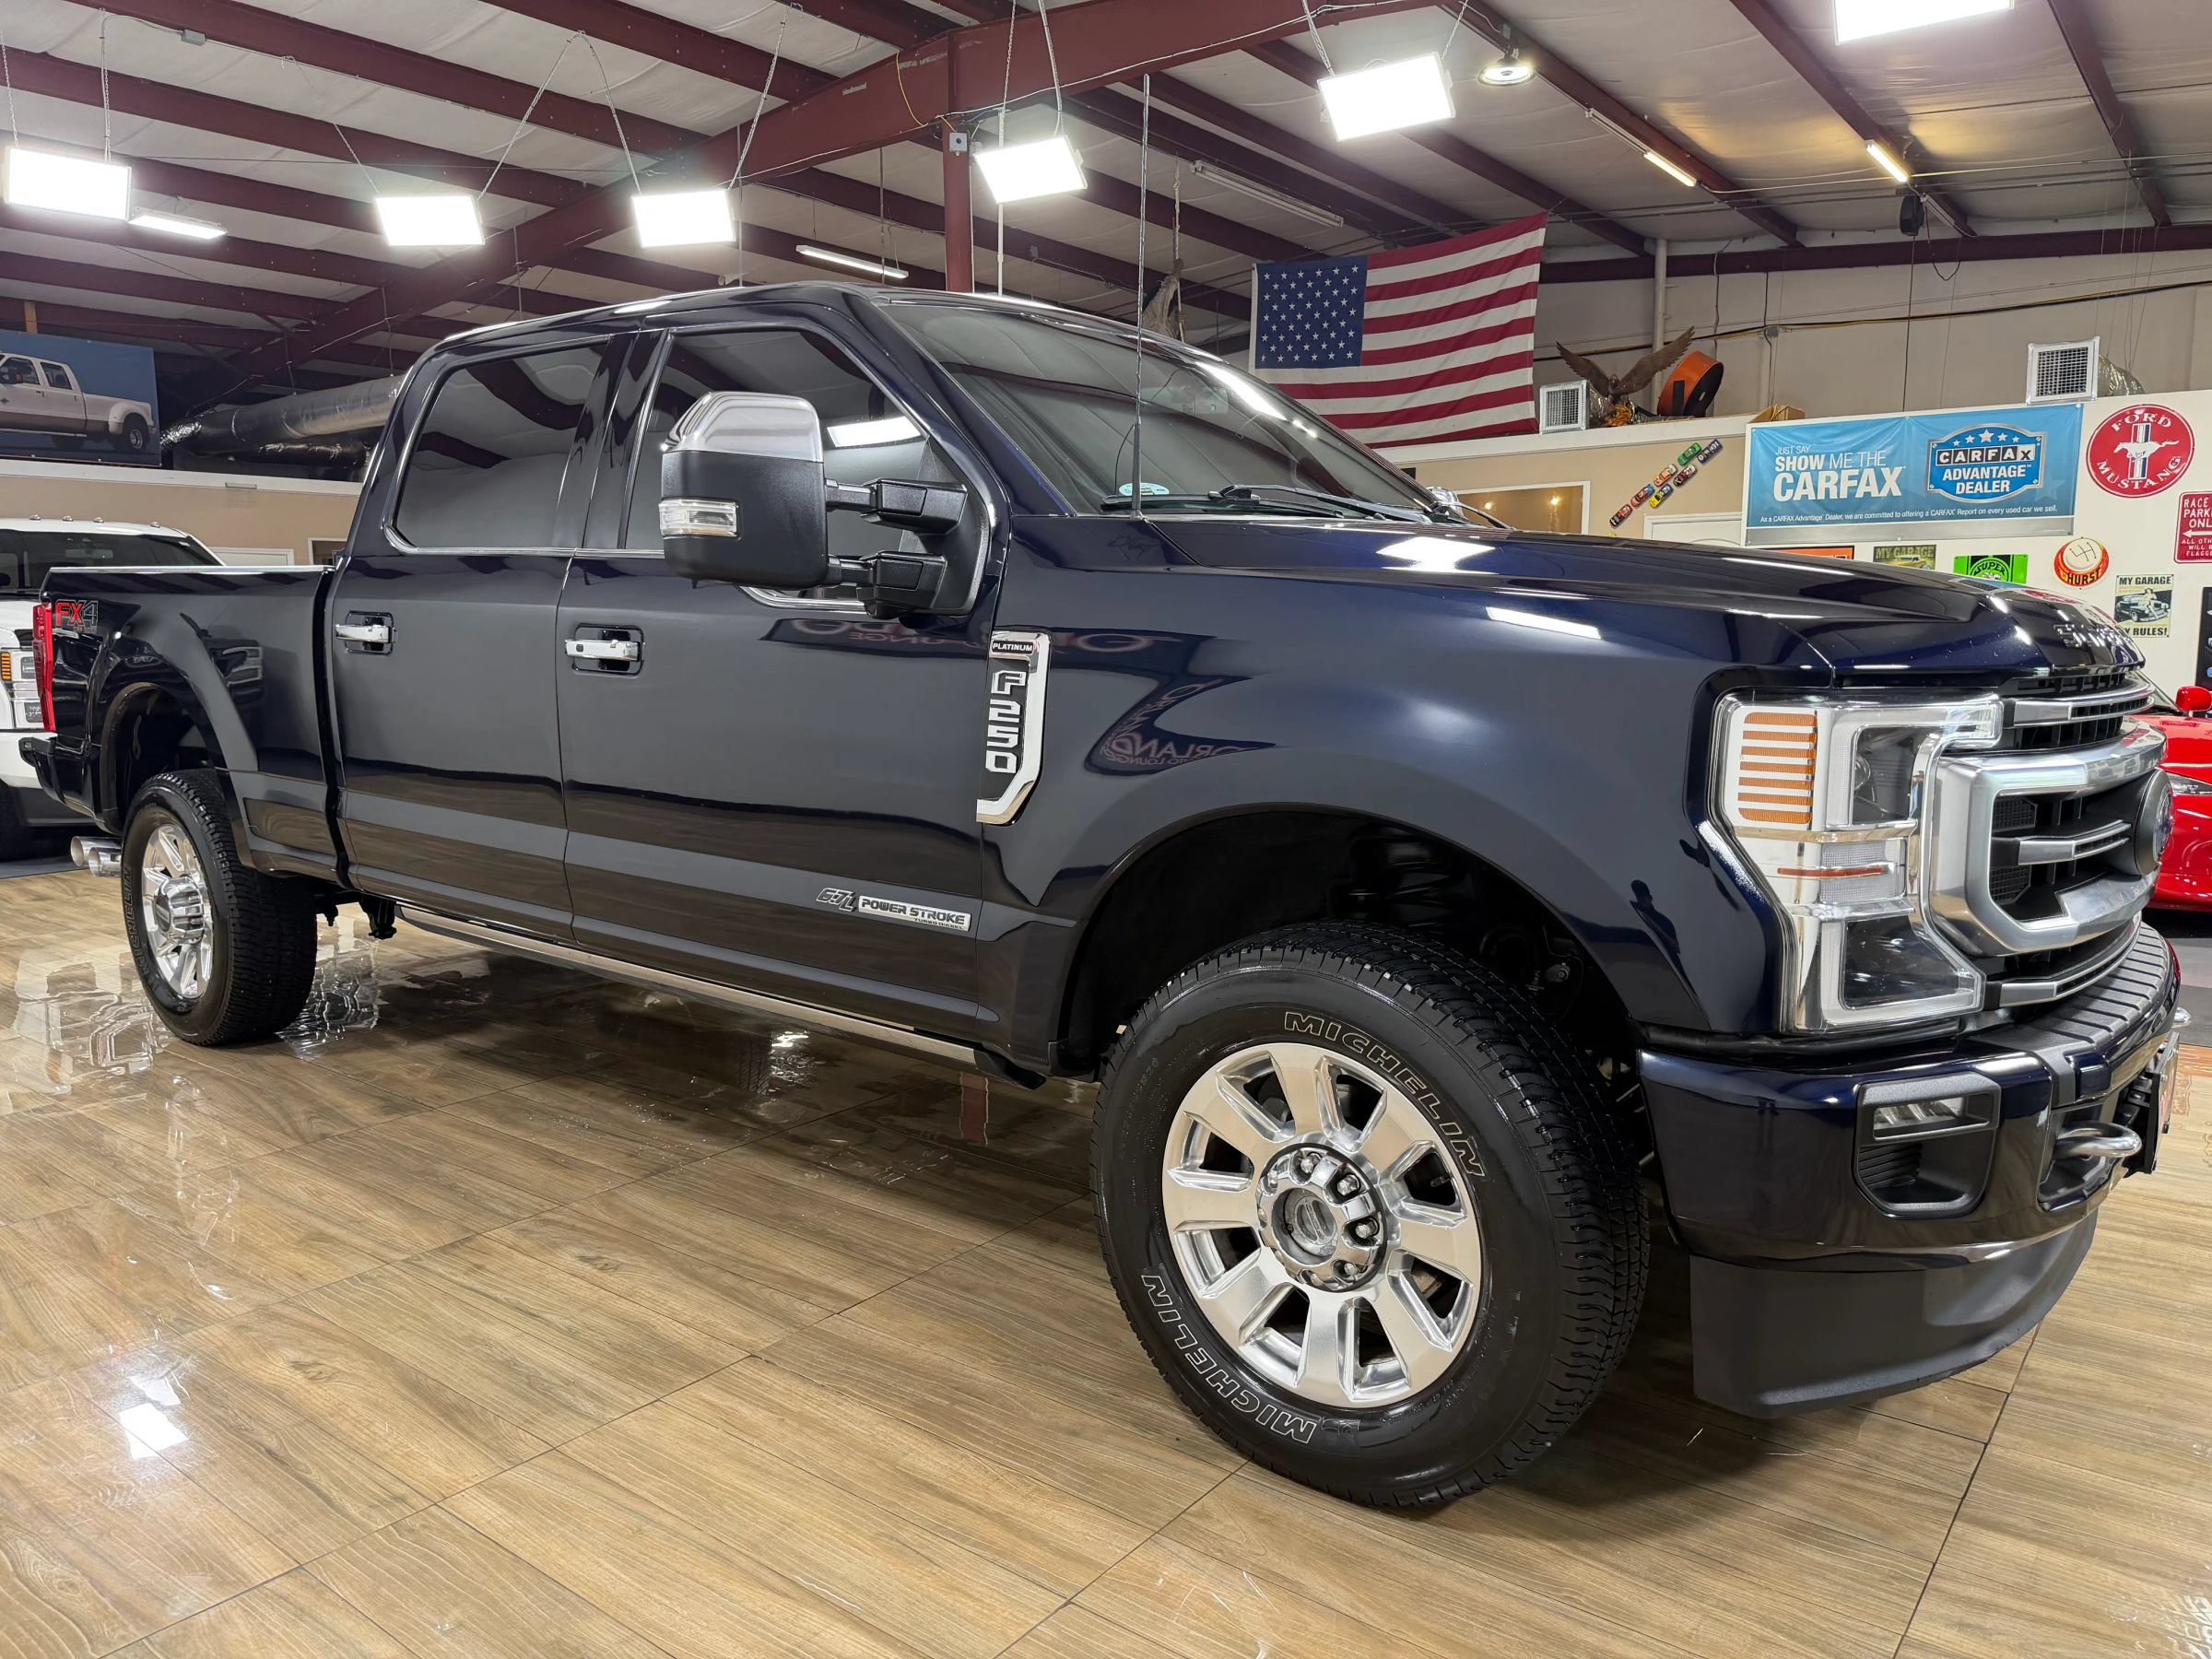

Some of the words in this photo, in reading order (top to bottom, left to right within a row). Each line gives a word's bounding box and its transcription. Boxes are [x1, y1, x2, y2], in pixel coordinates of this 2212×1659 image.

[2111, 412, 2171, 432] FORD
[1775, 446, 1793, 456] JUST
[1795, 444, 1811, 454] SAY
[1938, 447, 2033, 464] CARFAX
[1774, 454, 1825, 472] SHOW
[1829, 453, 1853, 469] ME
[1857, 450, 1887, 467] THE
[2097, 456, 2183, 490] MUSTANG
[1773, 466, 1903, 502] CARFAX
[1955, 479, 2010, 495] DEALER
[2183, 498, 2209, 508] RACE
[1864, 511, 1894, 519] committed
[1901, 510, 1924, 518] offering
[1957, 508, 1977, 516] Report
[1987, 507, 2004, 516] every
[2183, 508, 2212, 518] PARK
[2189, 519, 2212, 528] ONL
[1876, 547, 1892, 559] MY
[1893, 545, 1935, 559] GARAGE
[1974, 562, 2006, 576] SUPER
[2066, 566, 2101, 585] HURST
[2119, 577, 2134, 585] MY
[2136, 576, 2171, 585] GARAGE
[55, 599, 99, 628] FX4
[2133, 627, 2168, 636] RULES!
[992, 642, 1034, 653] PLATINUM
[984, 670, 1028, 774] F250
[816, 887, 857, 912] 6.7L
[861, 898, 907, 915] POWER
[909, 907, 965, 925] STROKE
[913, 917, 938, 925] TURBO
[1284, 1011, 1486, 1177] MICHELIN
[1140, 1275, 1318, 1444] MICHELIN
